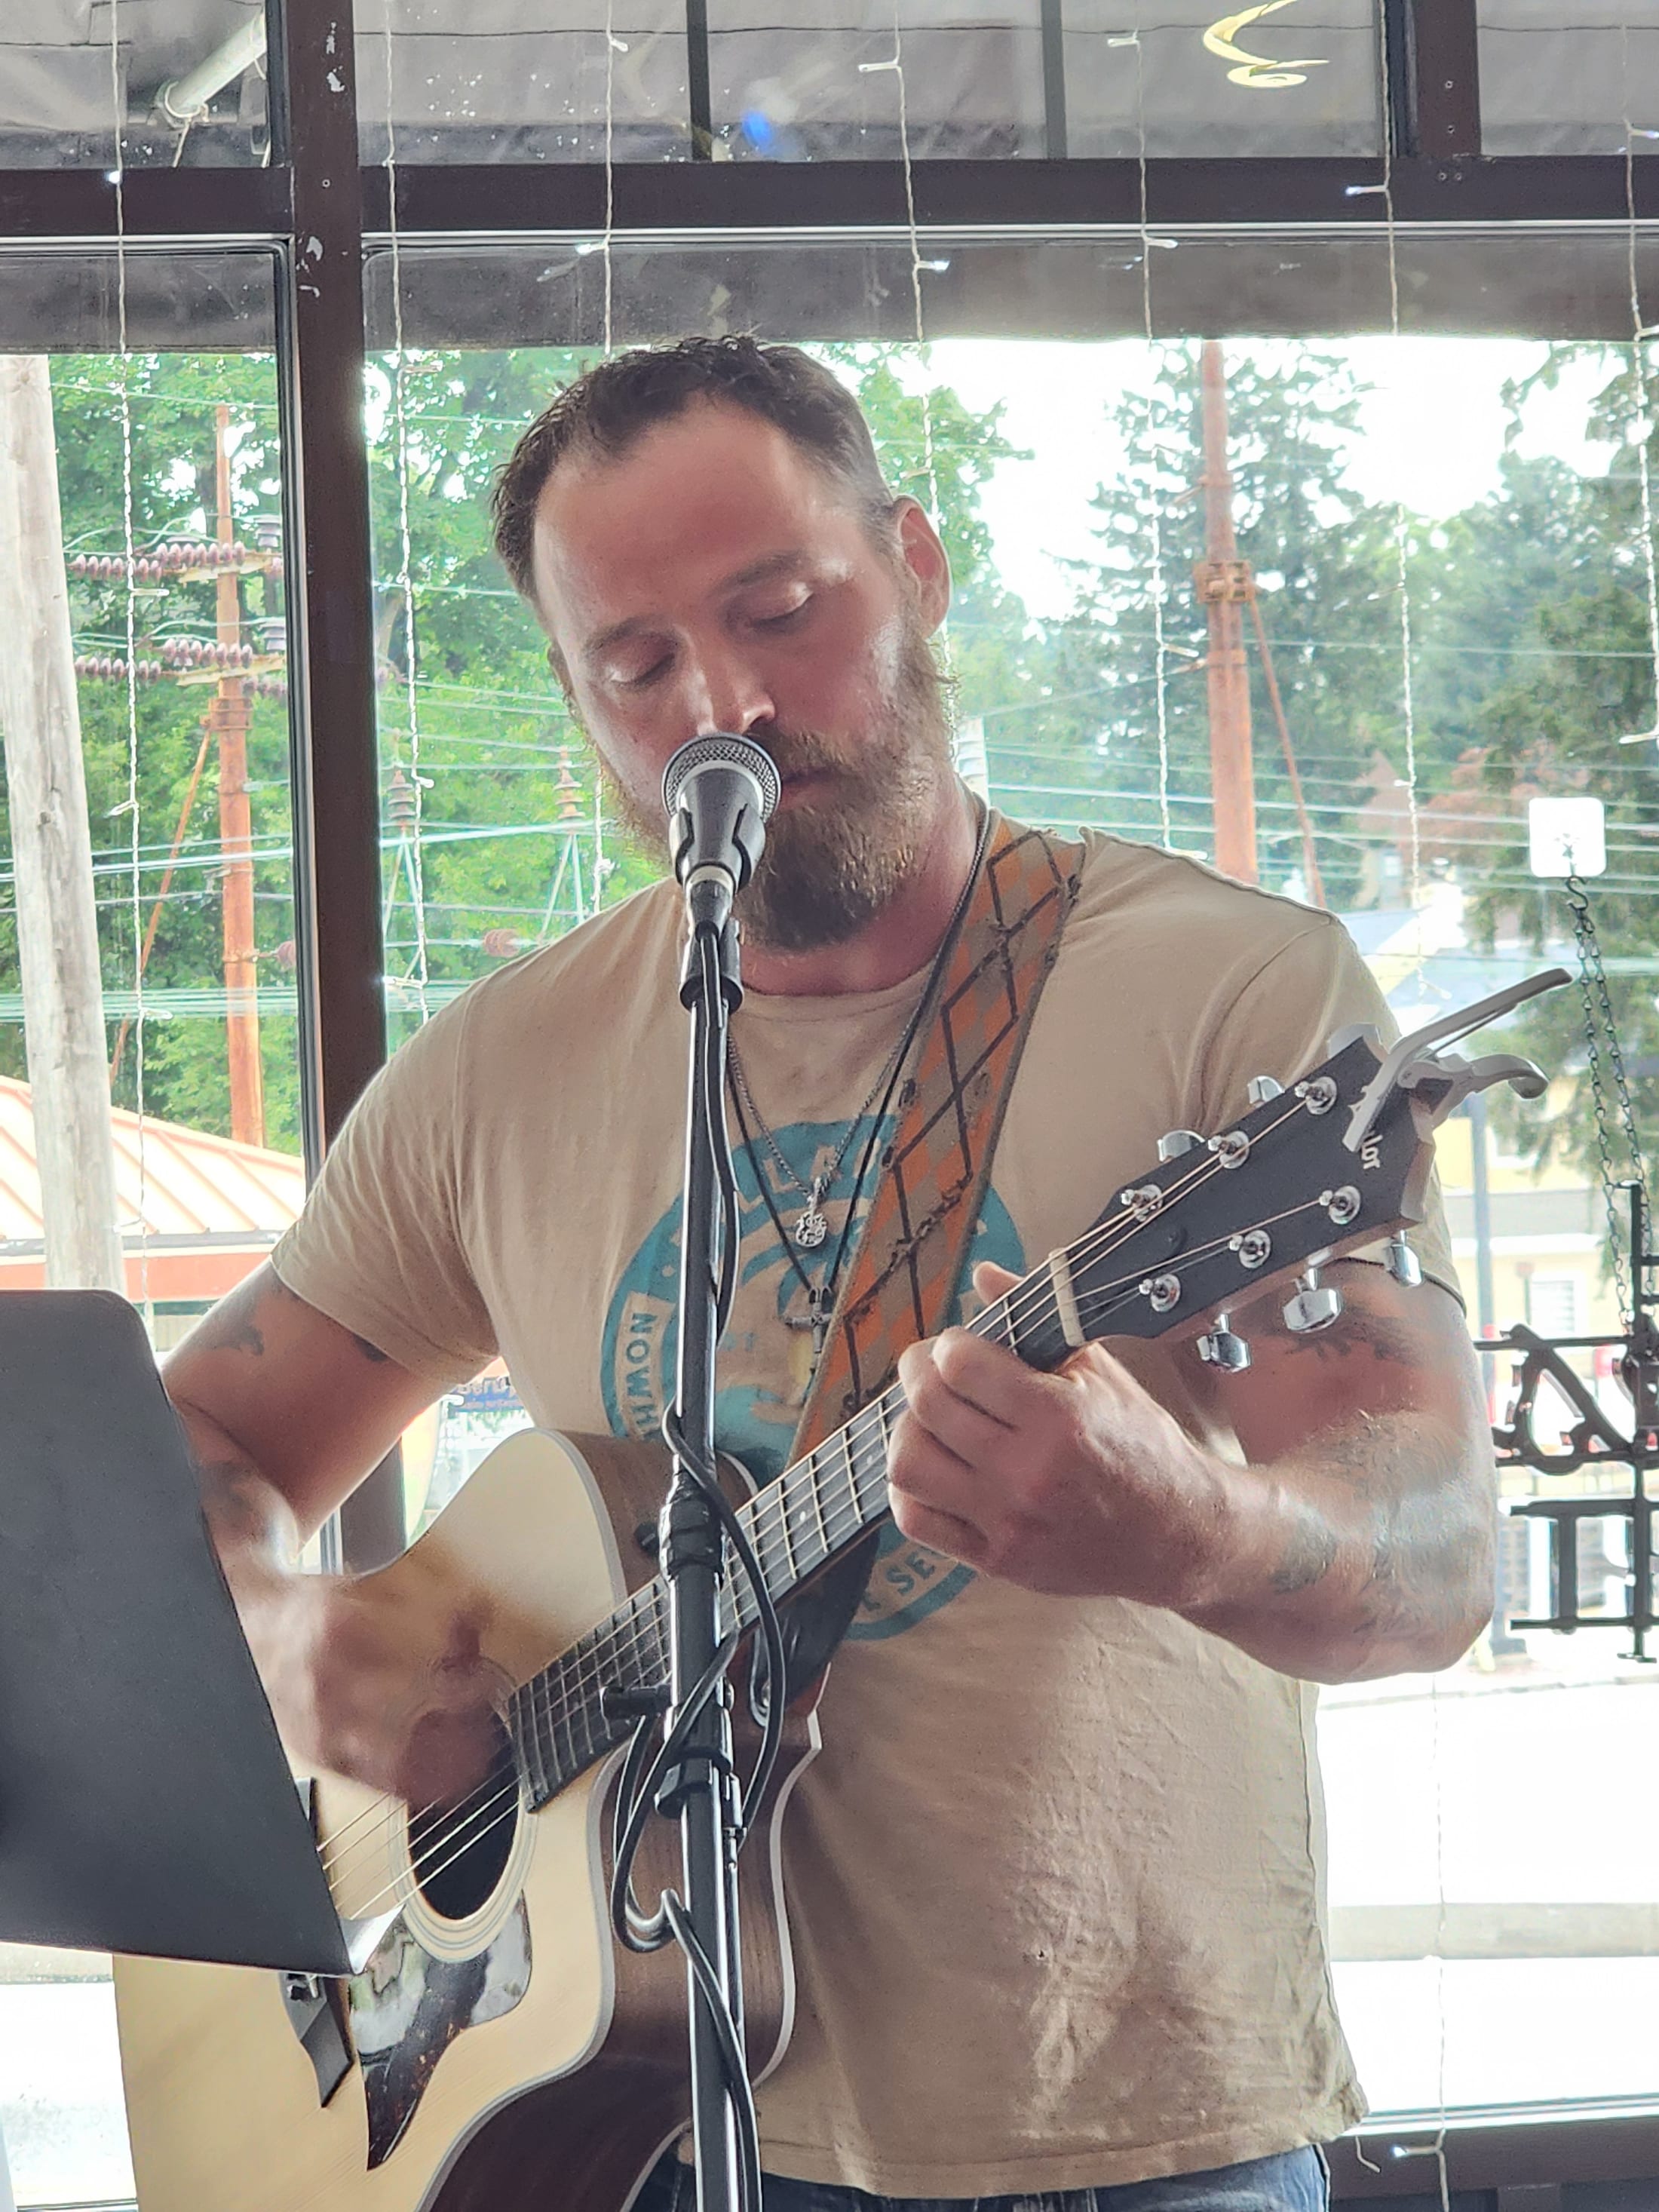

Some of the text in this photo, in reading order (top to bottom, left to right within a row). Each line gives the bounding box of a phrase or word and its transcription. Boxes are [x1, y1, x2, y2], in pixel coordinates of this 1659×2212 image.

[1360, 1133, 1383, 1170] lor
[625, 1313, 659, 1427] NOWH
[886, 1550, 937, 1597] SE
